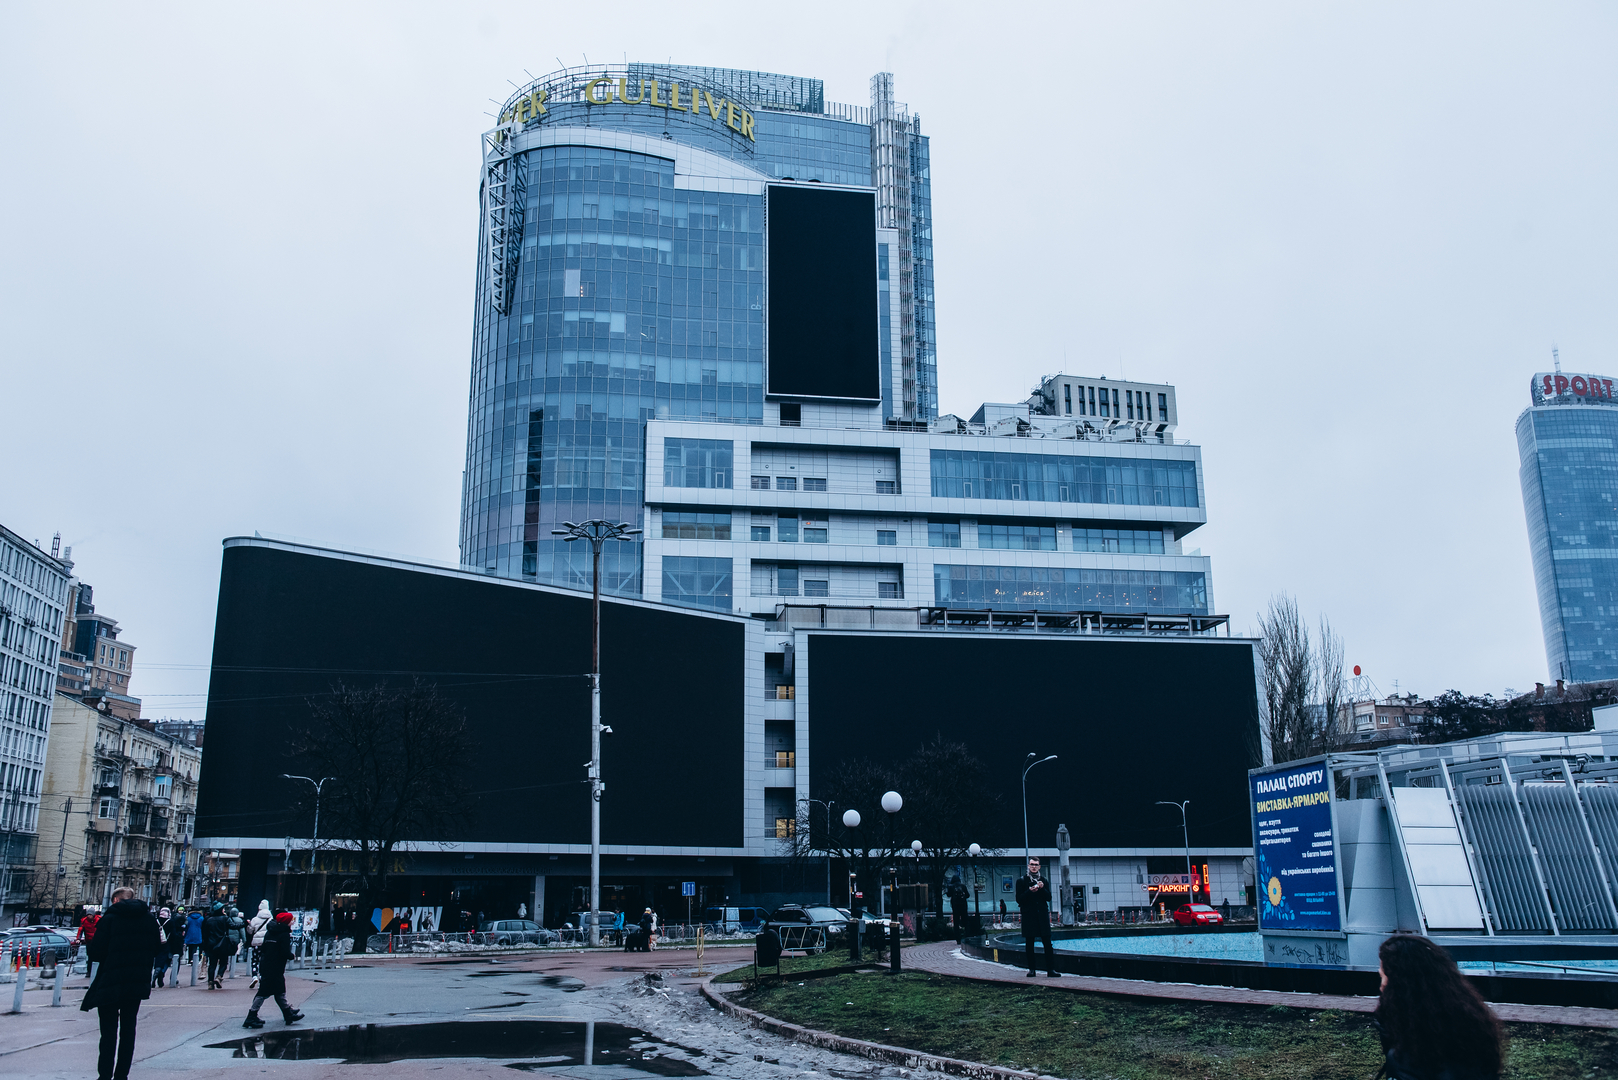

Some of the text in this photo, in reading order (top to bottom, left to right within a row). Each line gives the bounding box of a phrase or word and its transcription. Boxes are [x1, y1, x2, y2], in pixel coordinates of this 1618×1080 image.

[585, 77, 756, 143] GULLIVER
[1543, 374, 1613, 399] SPORT
[951, 567, 1064, 582] MERCATO
[1256, 769, 1324, 794] ПАЛАЦ СПОРТУ
[1256, 790, 1330, 813] ВИСТАВКА-ЯРМАРОК
[1158, 884, 1191, 893] ПАРКІНГ
